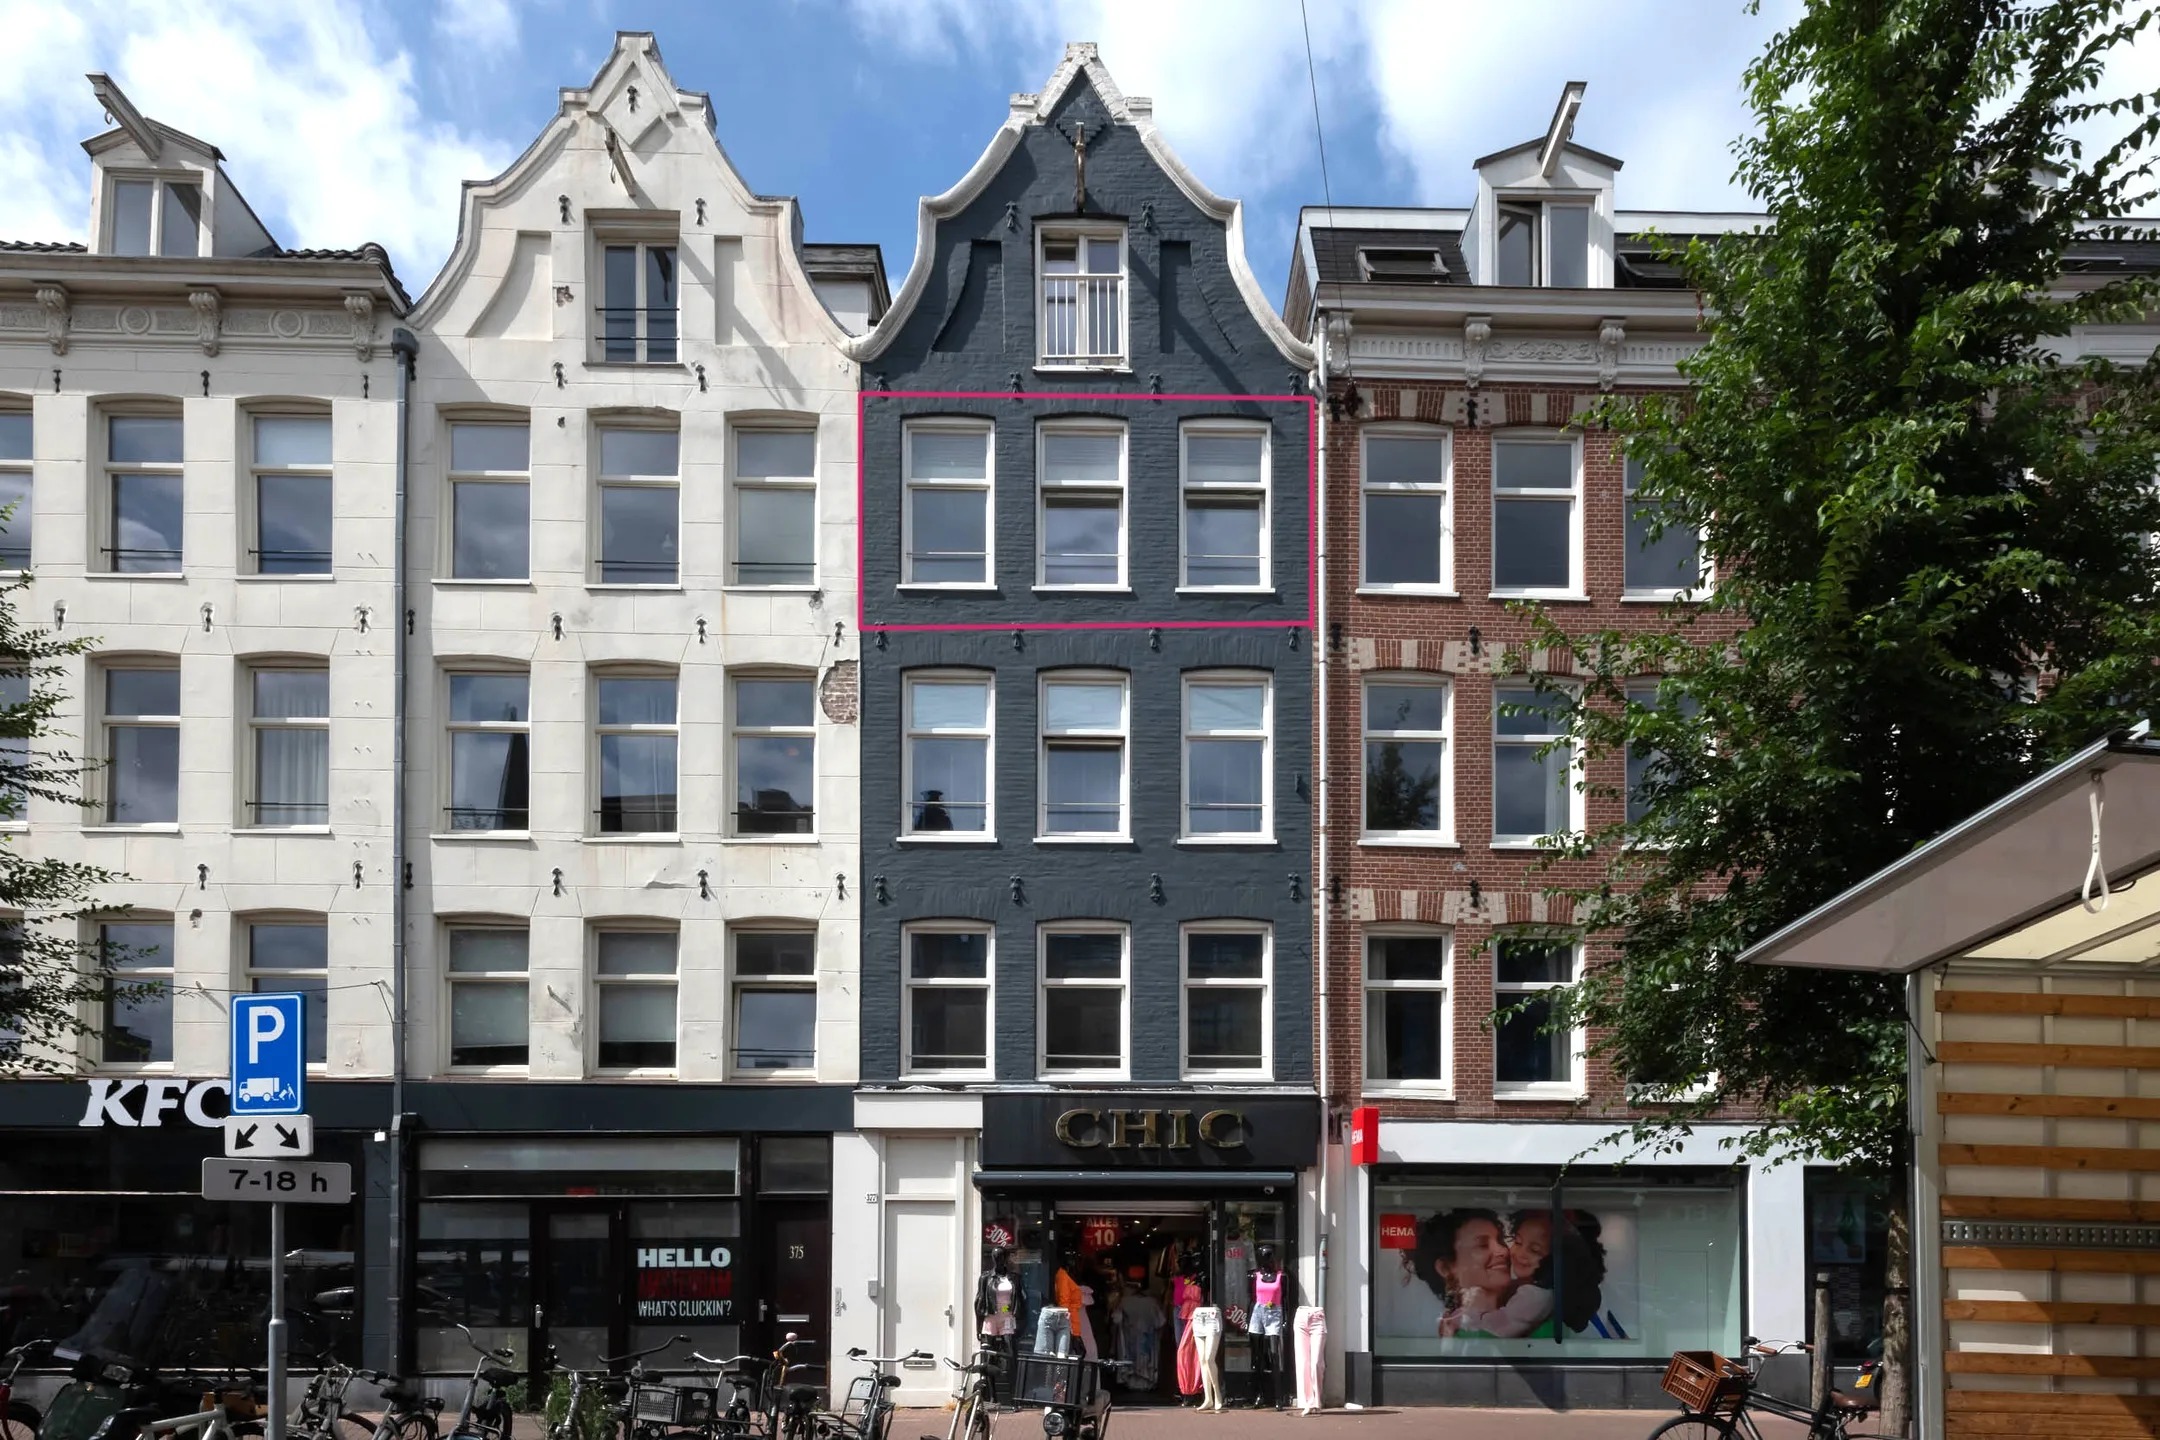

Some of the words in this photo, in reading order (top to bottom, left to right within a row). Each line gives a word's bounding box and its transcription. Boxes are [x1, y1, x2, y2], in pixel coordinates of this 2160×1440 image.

[249, 1006, 285, 1064] P
[79, 1079, 231, 1128] KFC
[1055, 1108, 1244, 1149] CHIC
[229, 1169, 296, 1192] 7-18
[311, 1172, 327, 1193] h
[1381, 1226, 1416, 1237] HEMA
[637, 1247, 731, 1268] HELLO
[789, 1245, 804, 1260] 375
[638, 1300, 677, 1317] WHAT'S
[679, 1300, 732, 1317] CLUCKIN'?
